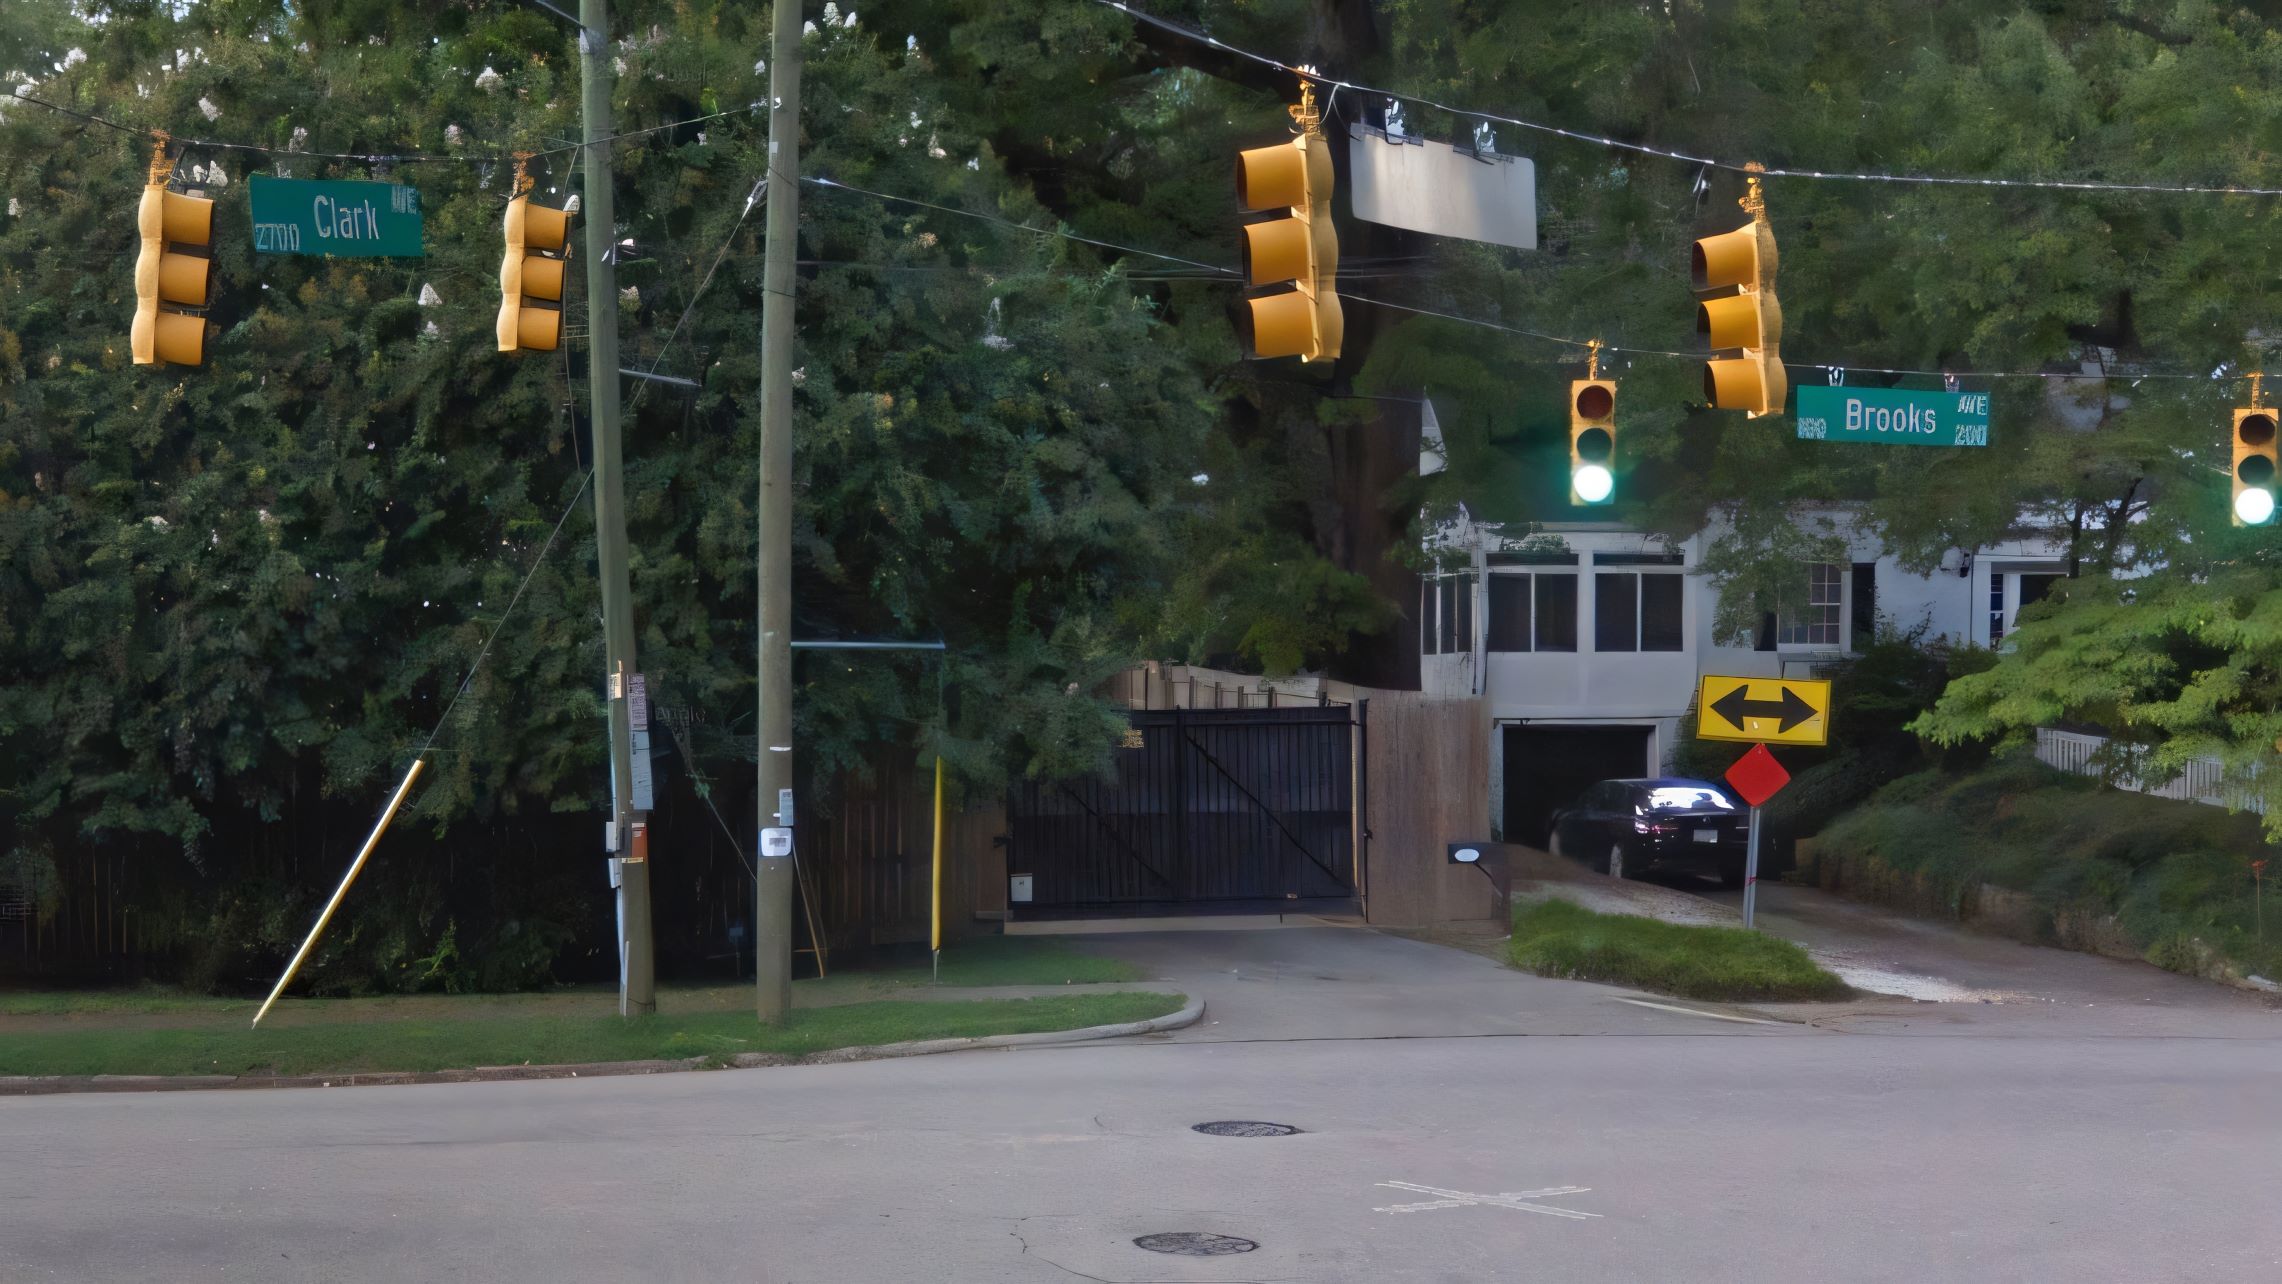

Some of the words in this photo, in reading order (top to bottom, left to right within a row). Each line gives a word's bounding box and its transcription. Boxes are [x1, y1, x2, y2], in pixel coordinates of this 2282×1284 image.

[313, 195, 379, 239] Clark
[254, 223, 300, 251] 2700
[1846, 398, 1936, 434] Brooks
